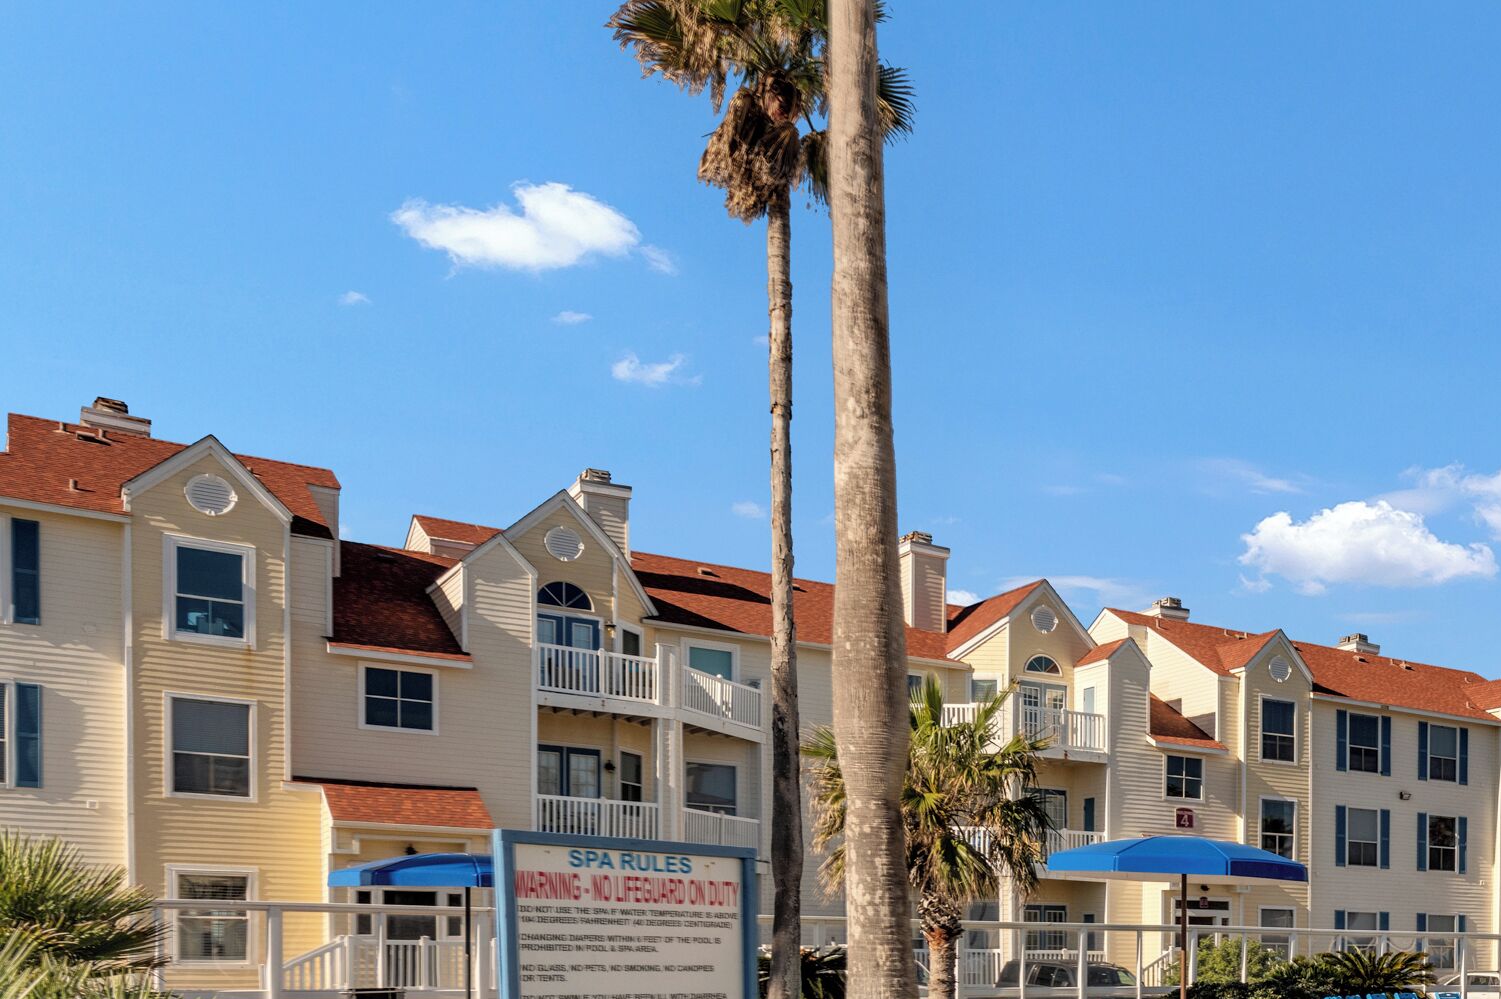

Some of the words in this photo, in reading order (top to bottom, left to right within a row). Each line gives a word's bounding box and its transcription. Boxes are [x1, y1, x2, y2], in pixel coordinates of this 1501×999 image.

[1180, 814, 1190, 827] 4
[568, 850, 615, 869] SPA
[620, 853, 693, 873] RULES
[516, 870, 582, 901] WARNING
[591, 874, 612, 902] NO
[616, 875, 685, 904] LIFEGUARD
[689, 879, 705, 905] ON
[709, 880, 739, 906] DUTY
[520, 905, 533, 913] DO
[535, 906, 553, 914] NOT
[555, 907, 573, 915] USE
[576, 907, 590, 915] THE
[592, 908, 608, 916] SPA
[620, 909, 646, 917] WATER
[650, 910, 704, 918] TEMPERATURE
[537, 916, 577, 925] DEGREES
[580, 918, 631, 926] FAHRENHEIT
[646, 919, 682, 927] DEGREES
[521, 934, 567, 942] CHANGING
[608, 935, 636, 943] WITHIN
[521, 944, 574, 952] PROHIBITED
